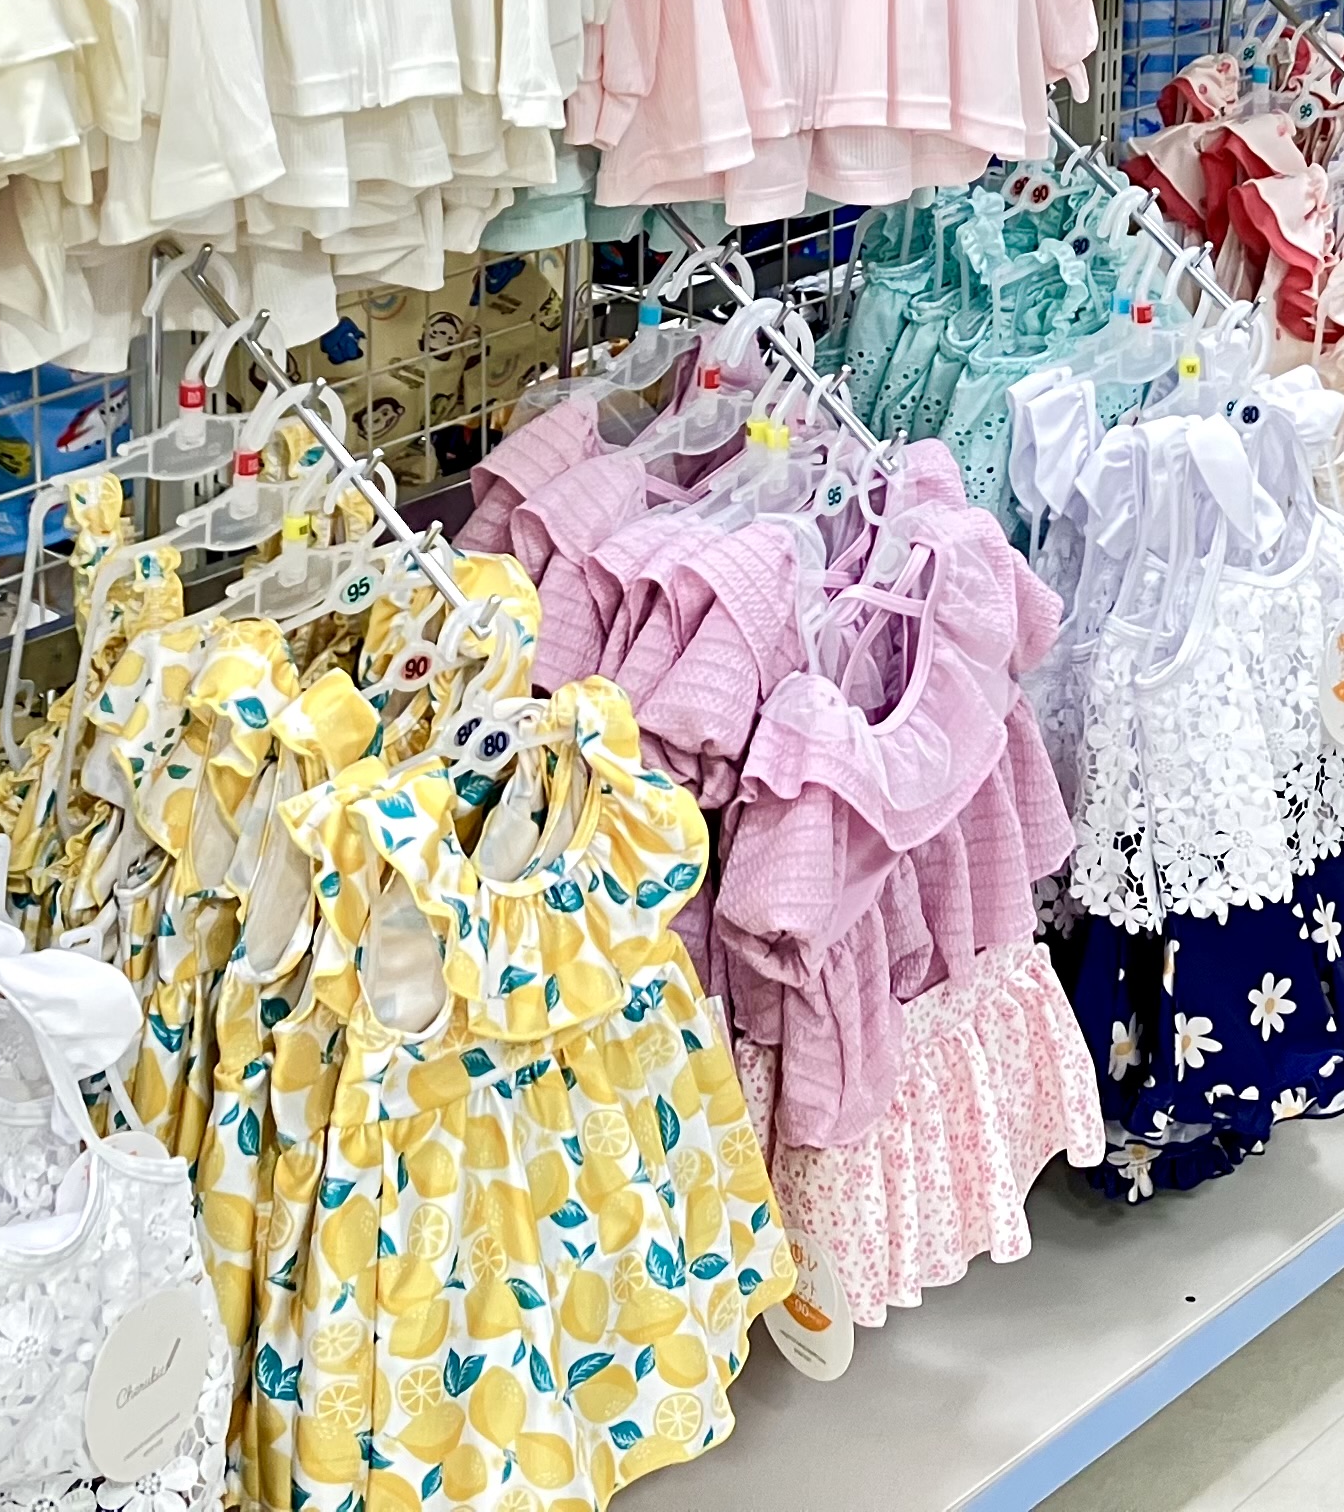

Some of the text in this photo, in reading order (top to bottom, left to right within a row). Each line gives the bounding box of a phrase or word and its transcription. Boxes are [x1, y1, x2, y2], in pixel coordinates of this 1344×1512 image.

[1032, 184, 1049, 204] 90
[1241, 405, 1260, 424] 80
[827, 486, 842, 506] 95
[347, 576, 370, 603] 95
[405, 655, 428, 680] 90
[483, 730, 507, 757] 80
